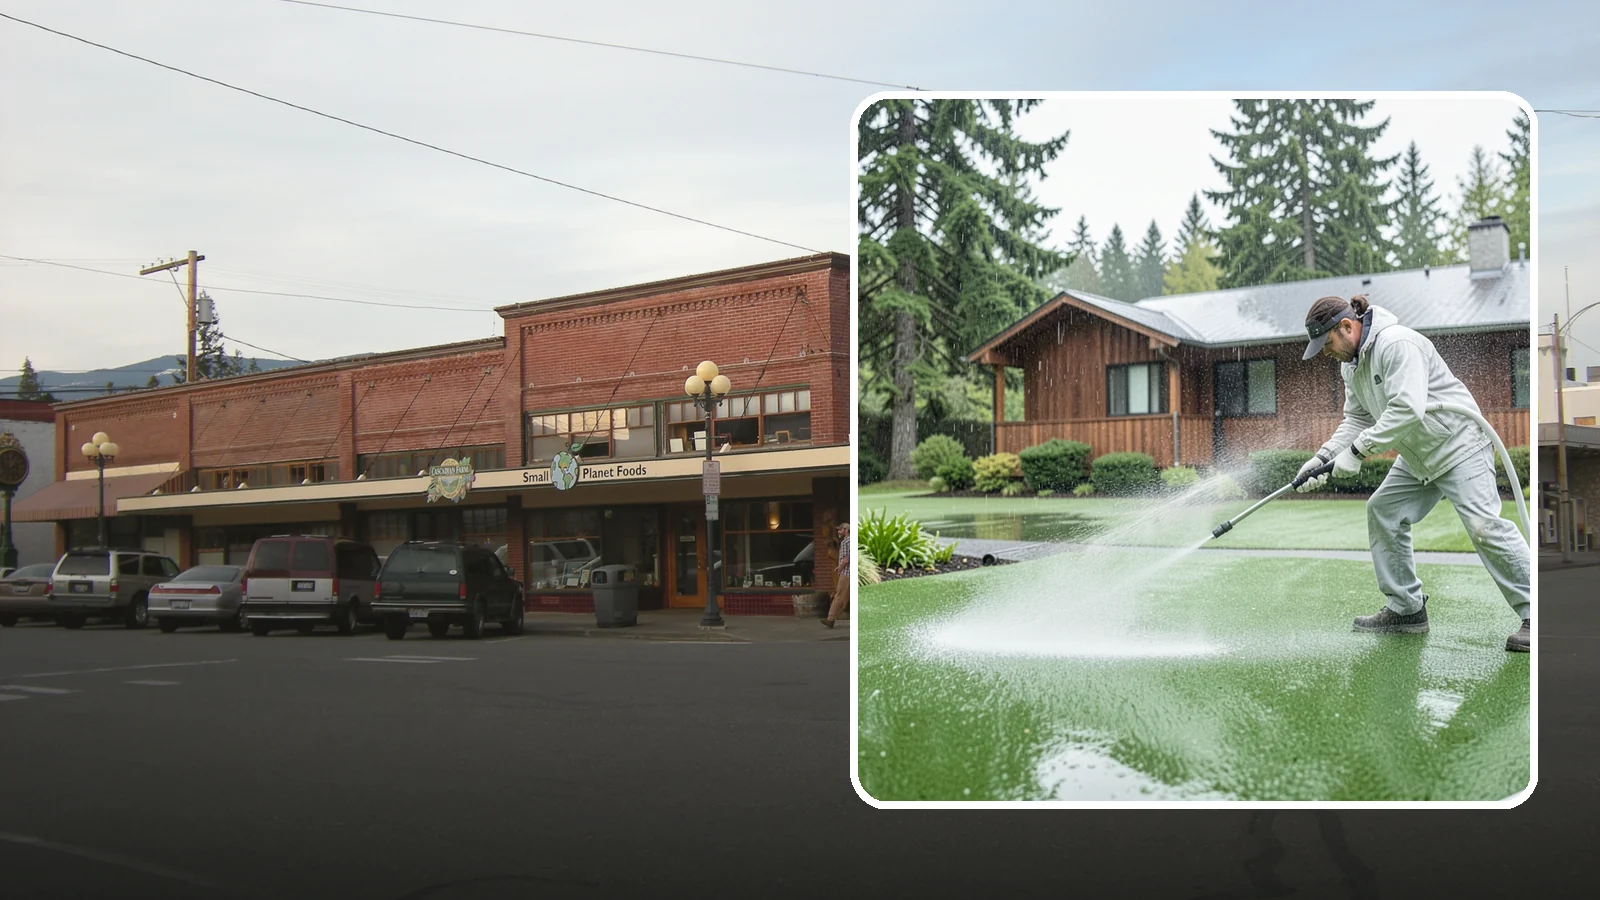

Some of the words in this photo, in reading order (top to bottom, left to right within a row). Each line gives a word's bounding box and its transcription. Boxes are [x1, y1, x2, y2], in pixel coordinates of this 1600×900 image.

[523, 471, 549, 482] Small
[583, 467, 614, 479] Planet
[617, 464, 647, 477] Foods
